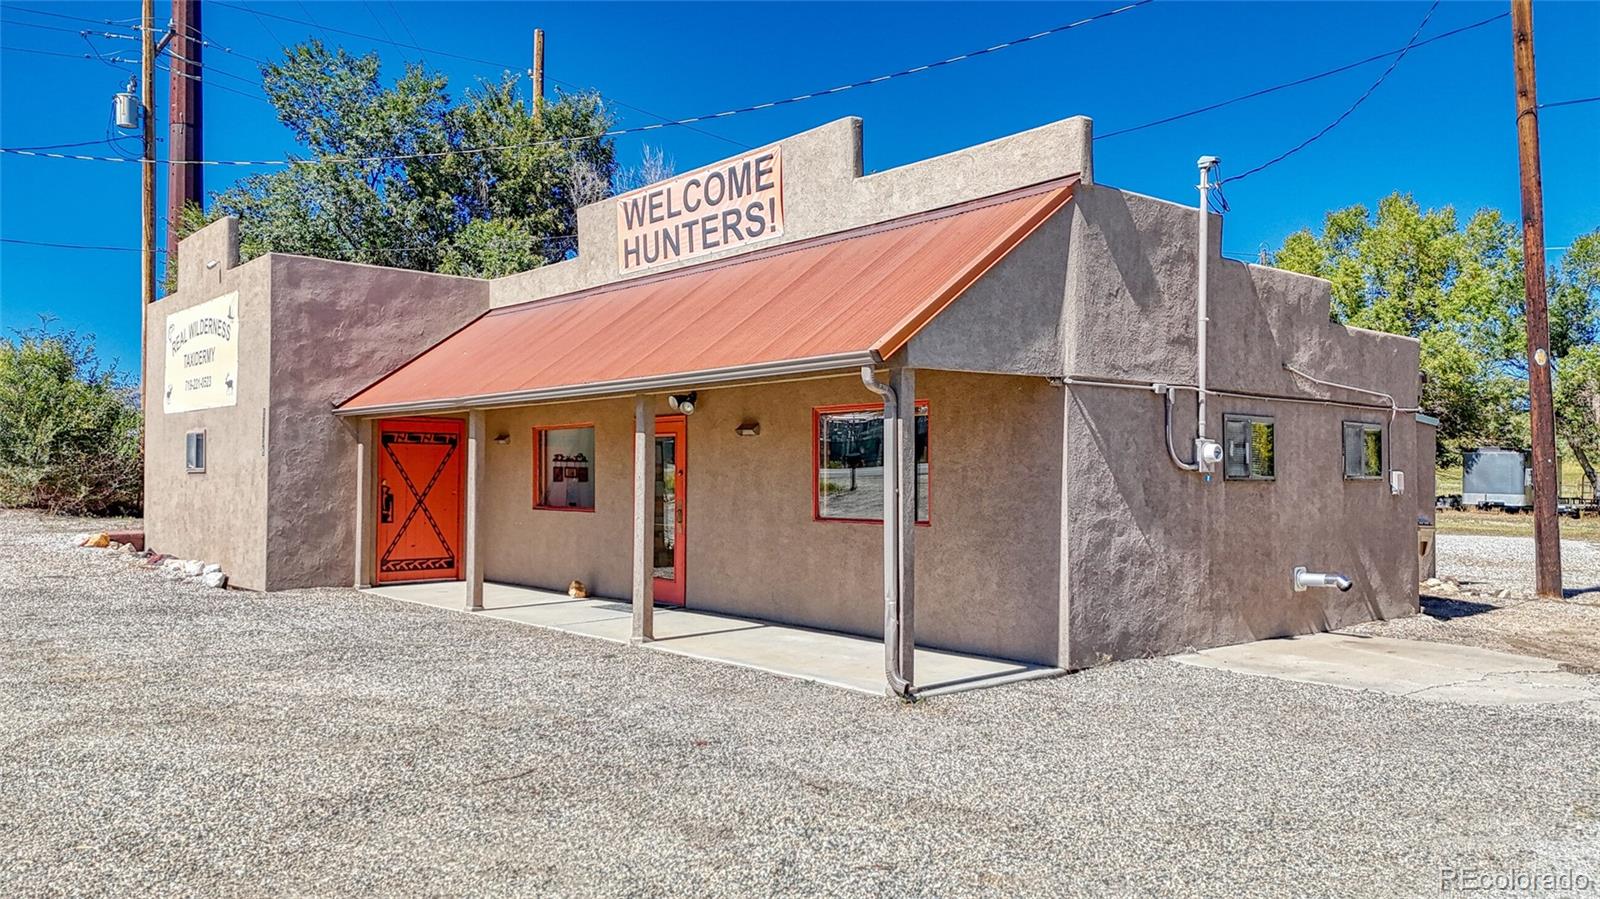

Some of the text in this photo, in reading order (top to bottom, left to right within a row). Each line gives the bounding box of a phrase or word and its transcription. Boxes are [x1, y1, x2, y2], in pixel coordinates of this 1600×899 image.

[622, 153, 775, 231] WELCOME
[623, 197, 776, 269] HUNTERS!
[171, 317, 231, 357] REAL WILDERNESS
[183, 346, 216, 369] TAXIDERMY
